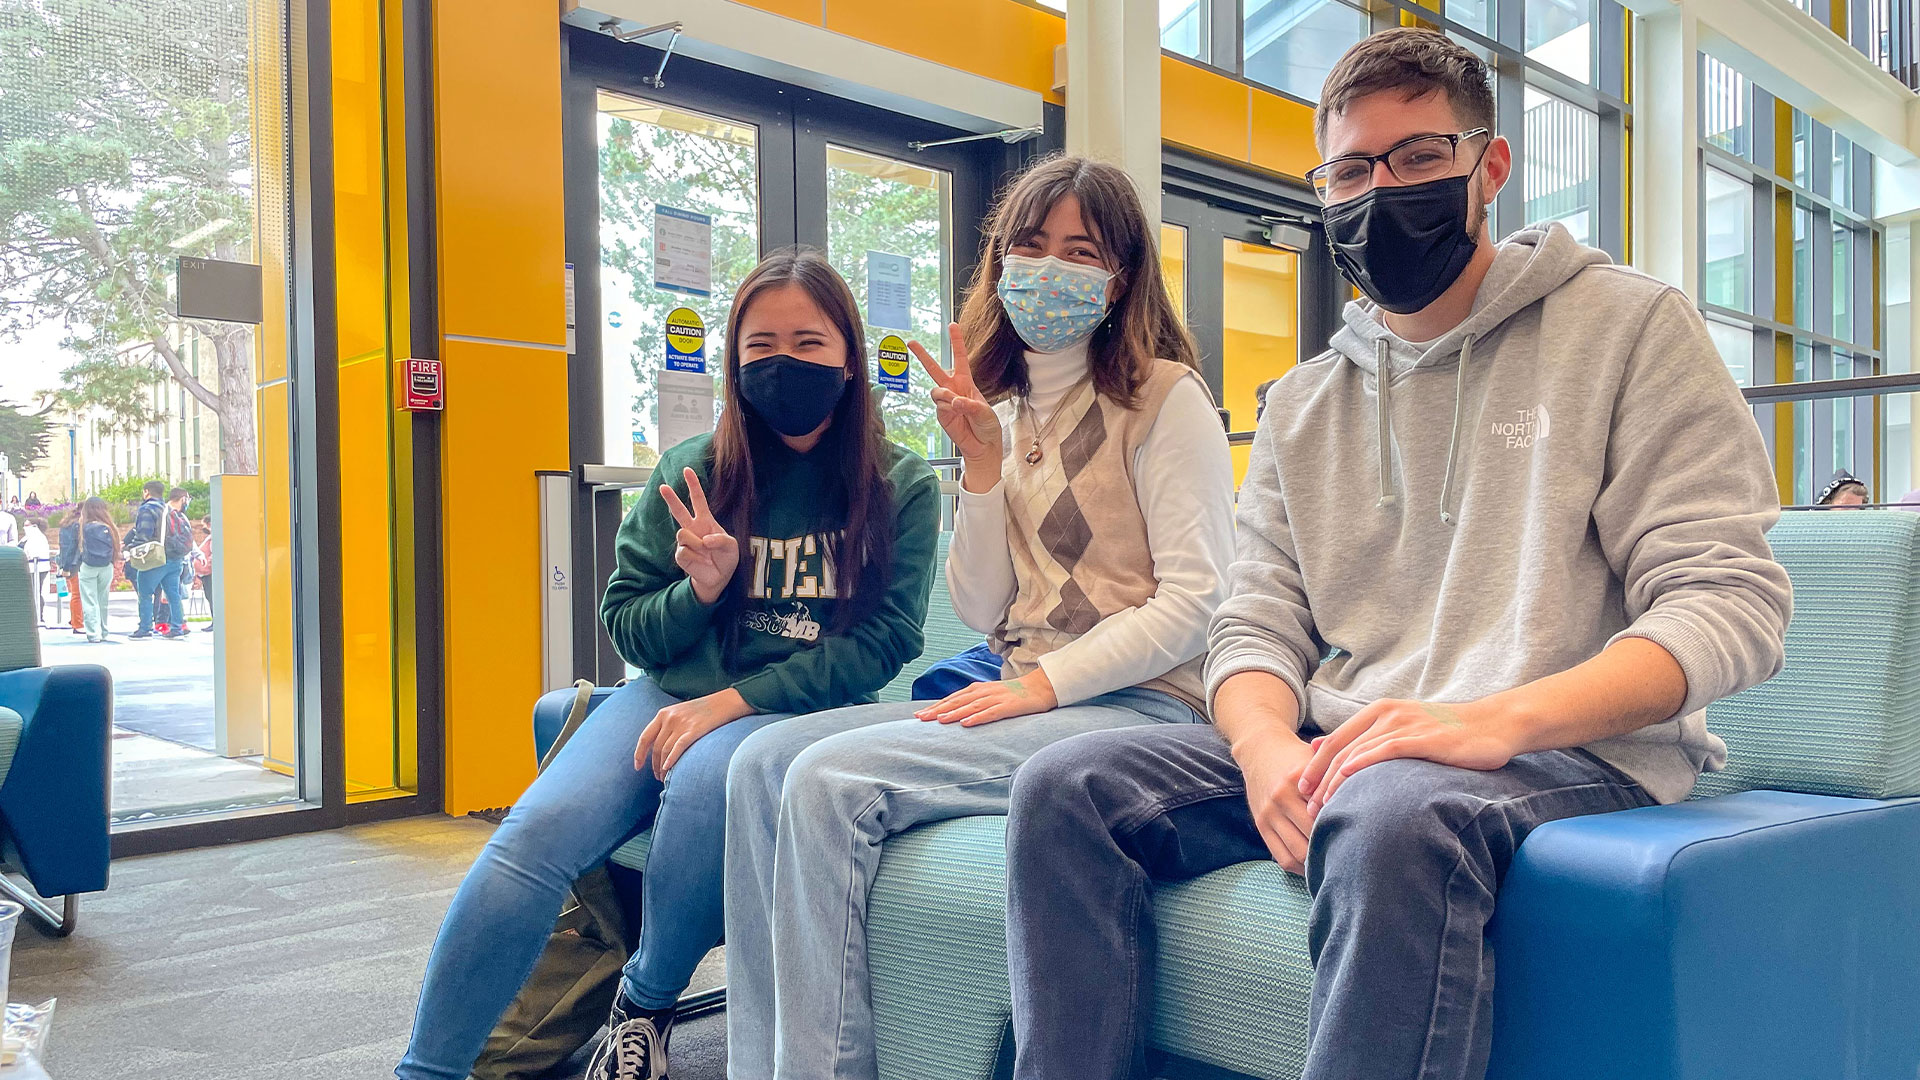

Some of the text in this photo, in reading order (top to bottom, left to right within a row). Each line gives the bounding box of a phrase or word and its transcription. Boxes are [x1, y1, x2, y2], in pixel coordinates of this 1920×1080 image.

[182, 260, 207, 270] EXIT
[671, 317, 700, 327] AUTOMATIC
[669, 326, 702, 337] CAUTION
[678, 337, 694, 345] DOOR
[668, 354, 704, 363] ACTIVATE SWITCH
[881, 351, 907, 361] CAUTION
[410, 361, 438, 373] FIRE
[1516, 406, 1538, 422] THE
